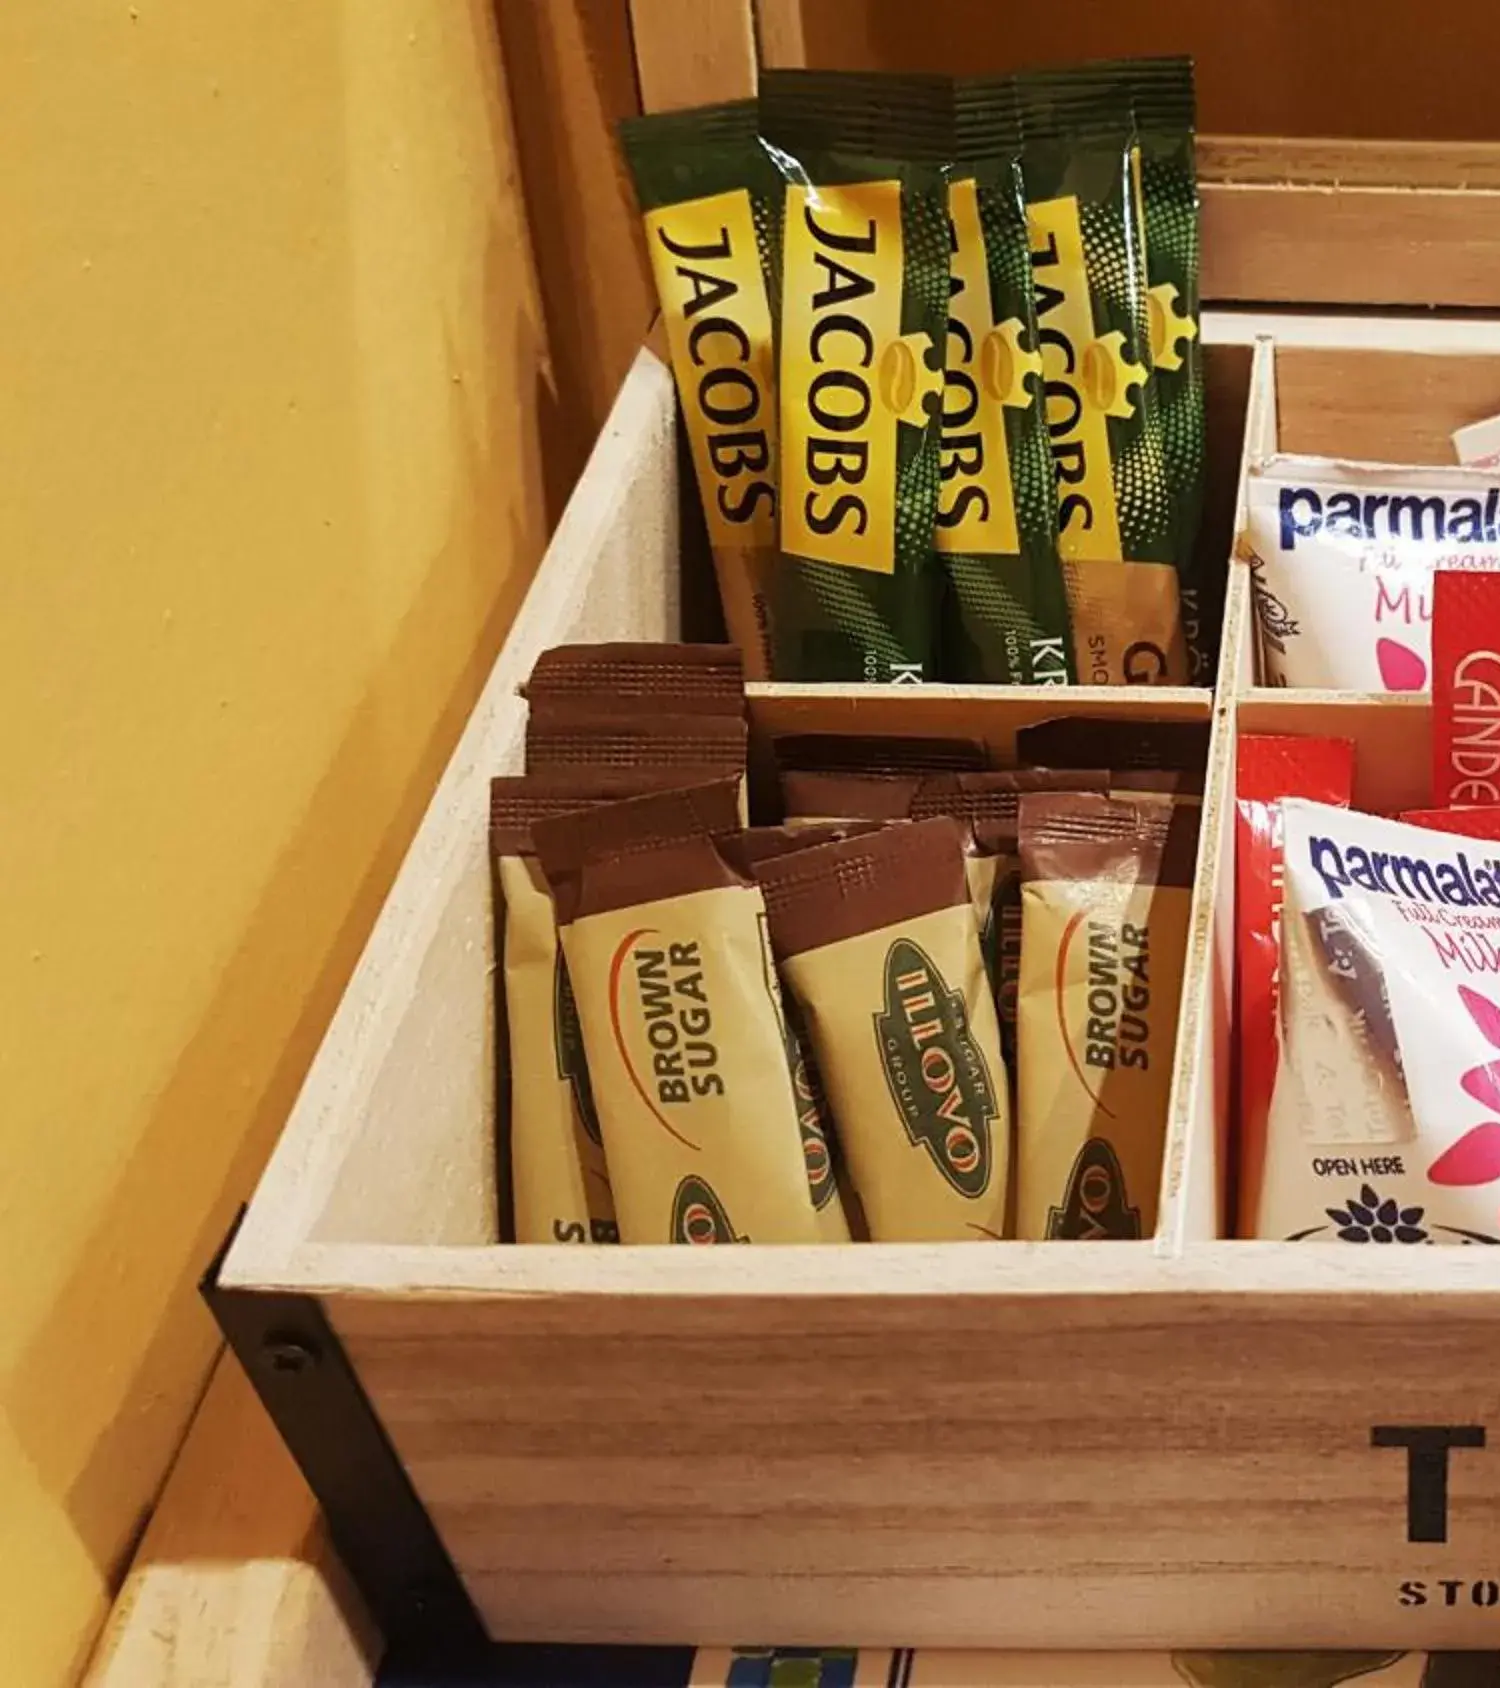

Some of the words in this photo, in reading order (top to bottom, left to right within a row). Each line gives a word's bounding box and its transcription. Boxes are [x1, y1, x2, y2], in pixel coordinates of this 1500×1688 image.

[657, 225, 778, 524] JACOBS
[804, 206, 878, 537] JACOBS
[633, 949, 692, 1104] BROWN
[669, 940, 725, 1098] SUGAR
[896, 968, 981, 1173] ILLOVO
[1085, 920, 1120, 1071] BROWN
[1118, 920, 1151, 1072] SUGAR
[1313, 1157, 1358, 1176] OPEN
[1360, 1155, 1406, 1174] HERE
